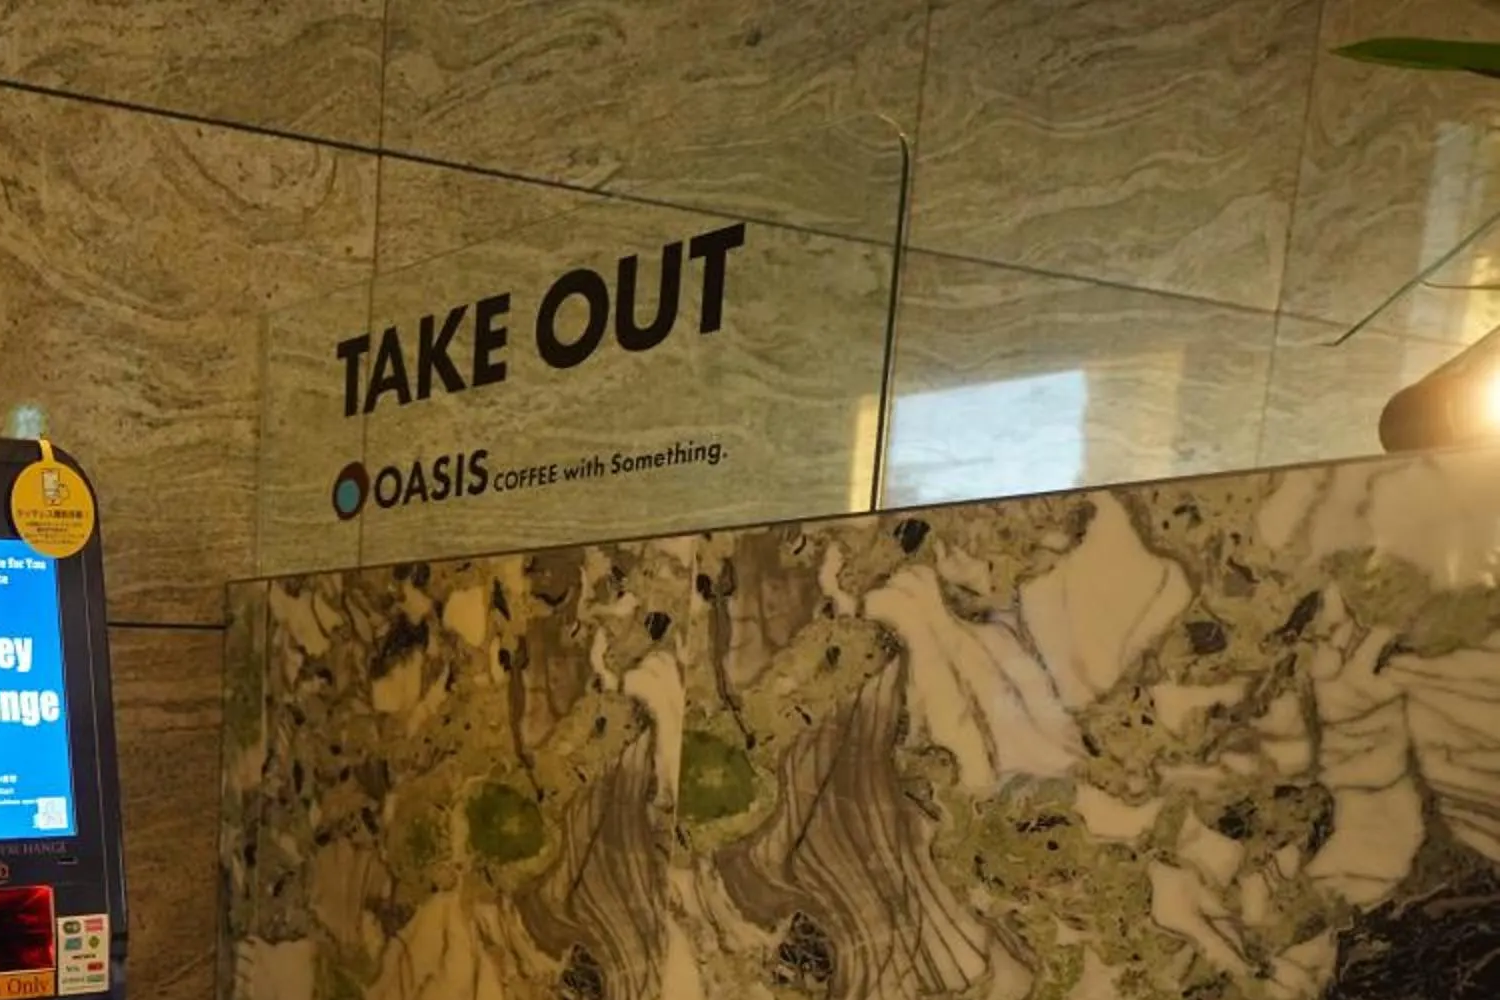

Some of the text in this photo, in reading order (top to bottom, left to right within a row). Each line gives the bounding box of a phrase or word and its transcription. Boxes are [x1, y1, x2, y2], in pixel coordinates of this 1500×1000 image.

[336, 222, 746, 418] TAKE OUT
[374, 440, 729, 509] OASIS COFFEE with Something.
[7, 975, 50, 994] Only
